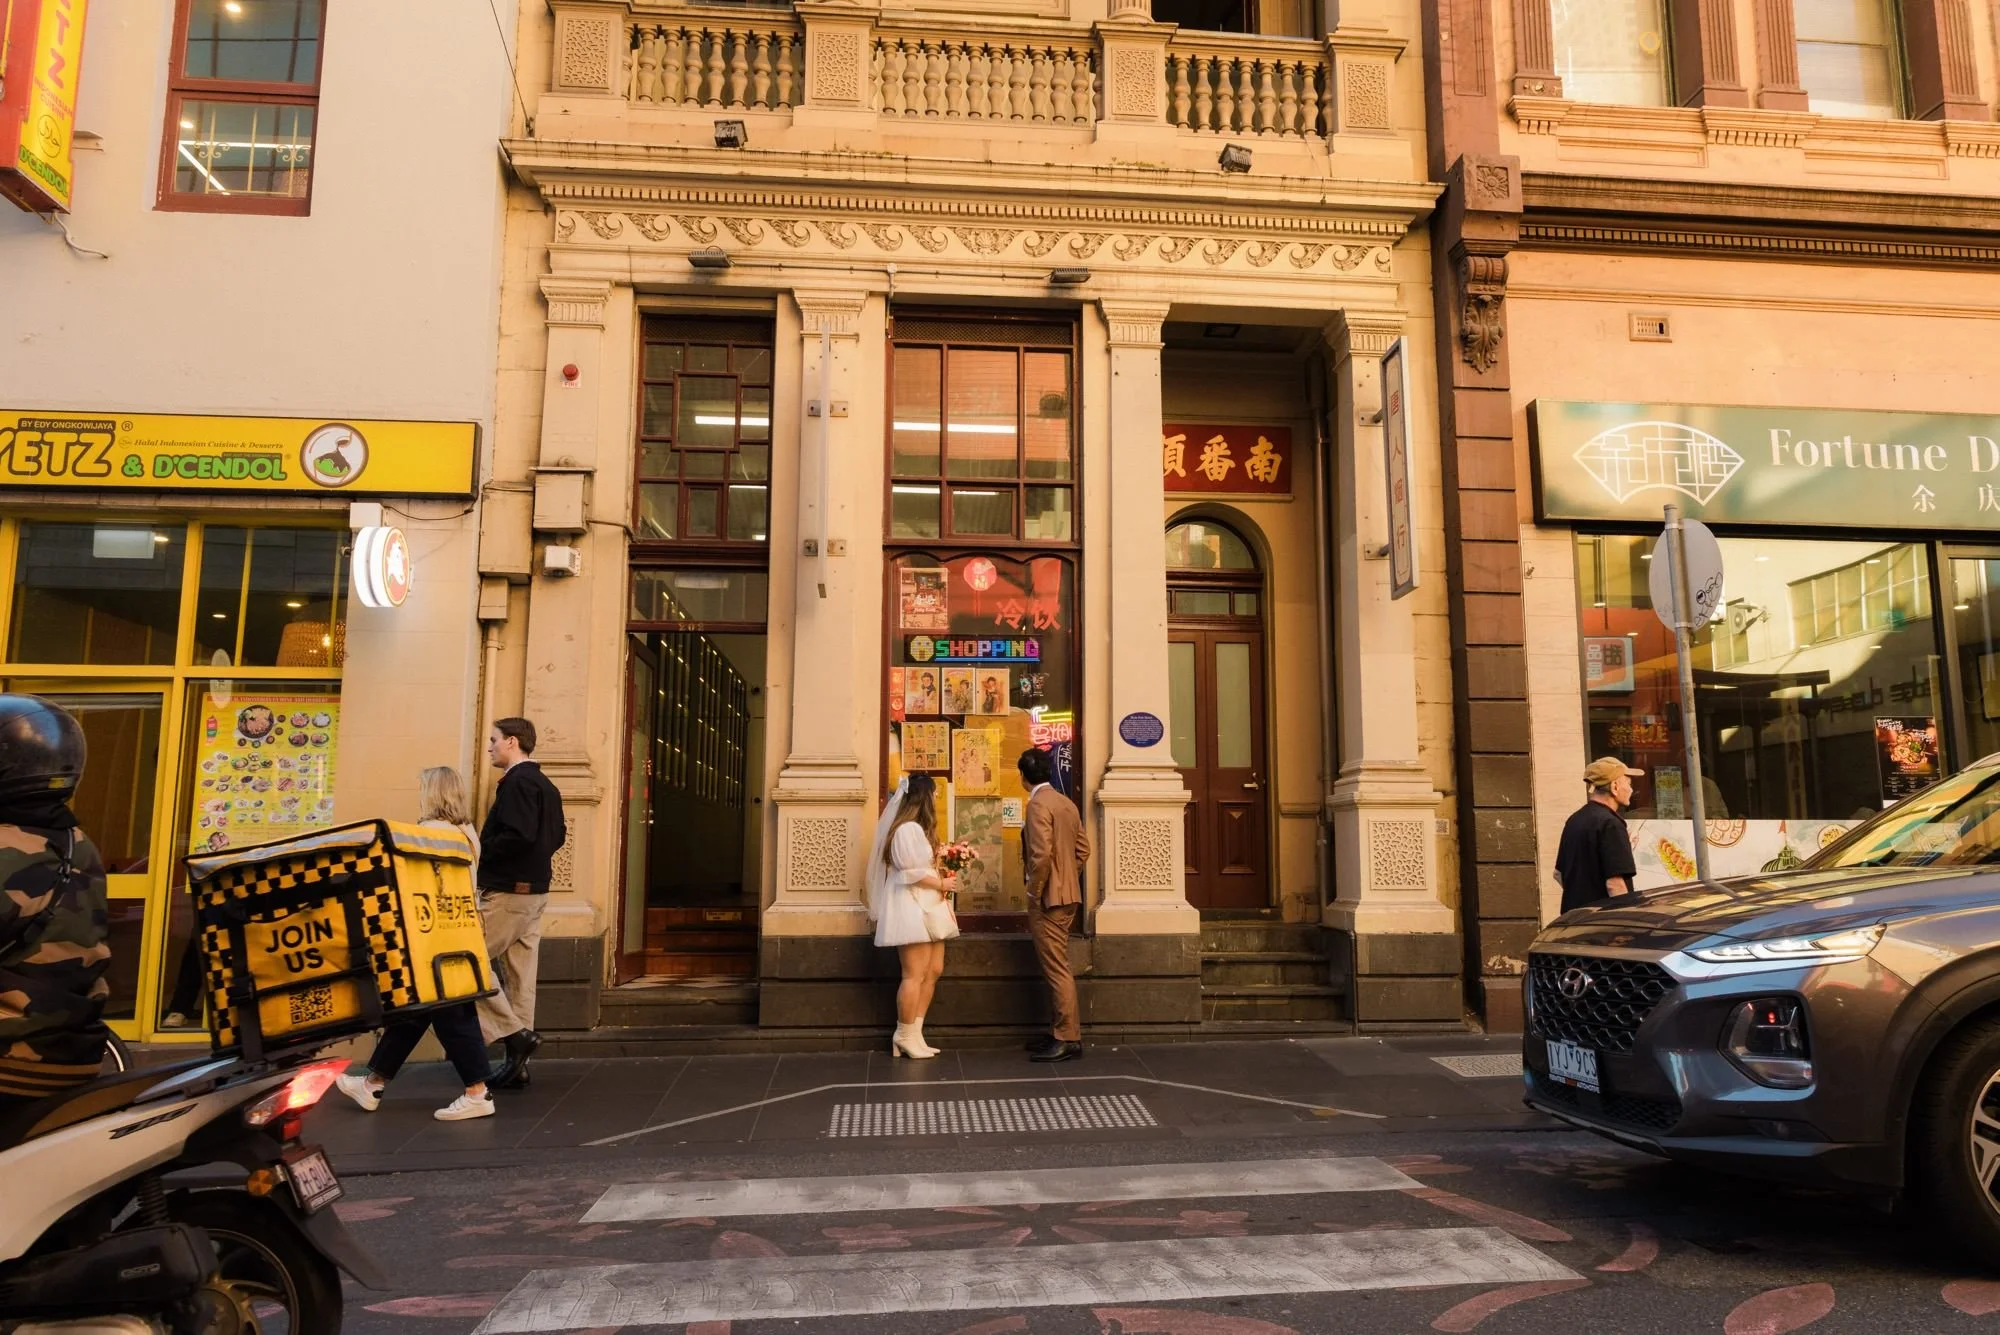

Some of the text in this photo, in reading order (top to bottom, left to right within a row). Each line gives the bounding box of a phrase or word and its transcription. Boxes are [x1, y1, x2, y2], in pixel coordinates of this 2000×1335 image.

[21, 420, 114, 430] BY EDY ONGKOWIJAYA
[134, 439, 158, 447] Halal
[160, 440, 207, 448] Indonesian
[208, 441, 238, 449] Cuisine
[1767, 428, 1949, 472] Fortune
[121, 454, 287, 480] & D'CENDOL
[994, 598, 1061, 631] 冷饮
[935, 639, 1039, 657] SHOPPING
[265, 918, 333, 953] JOIN
[283, 948, 324, 973] US
